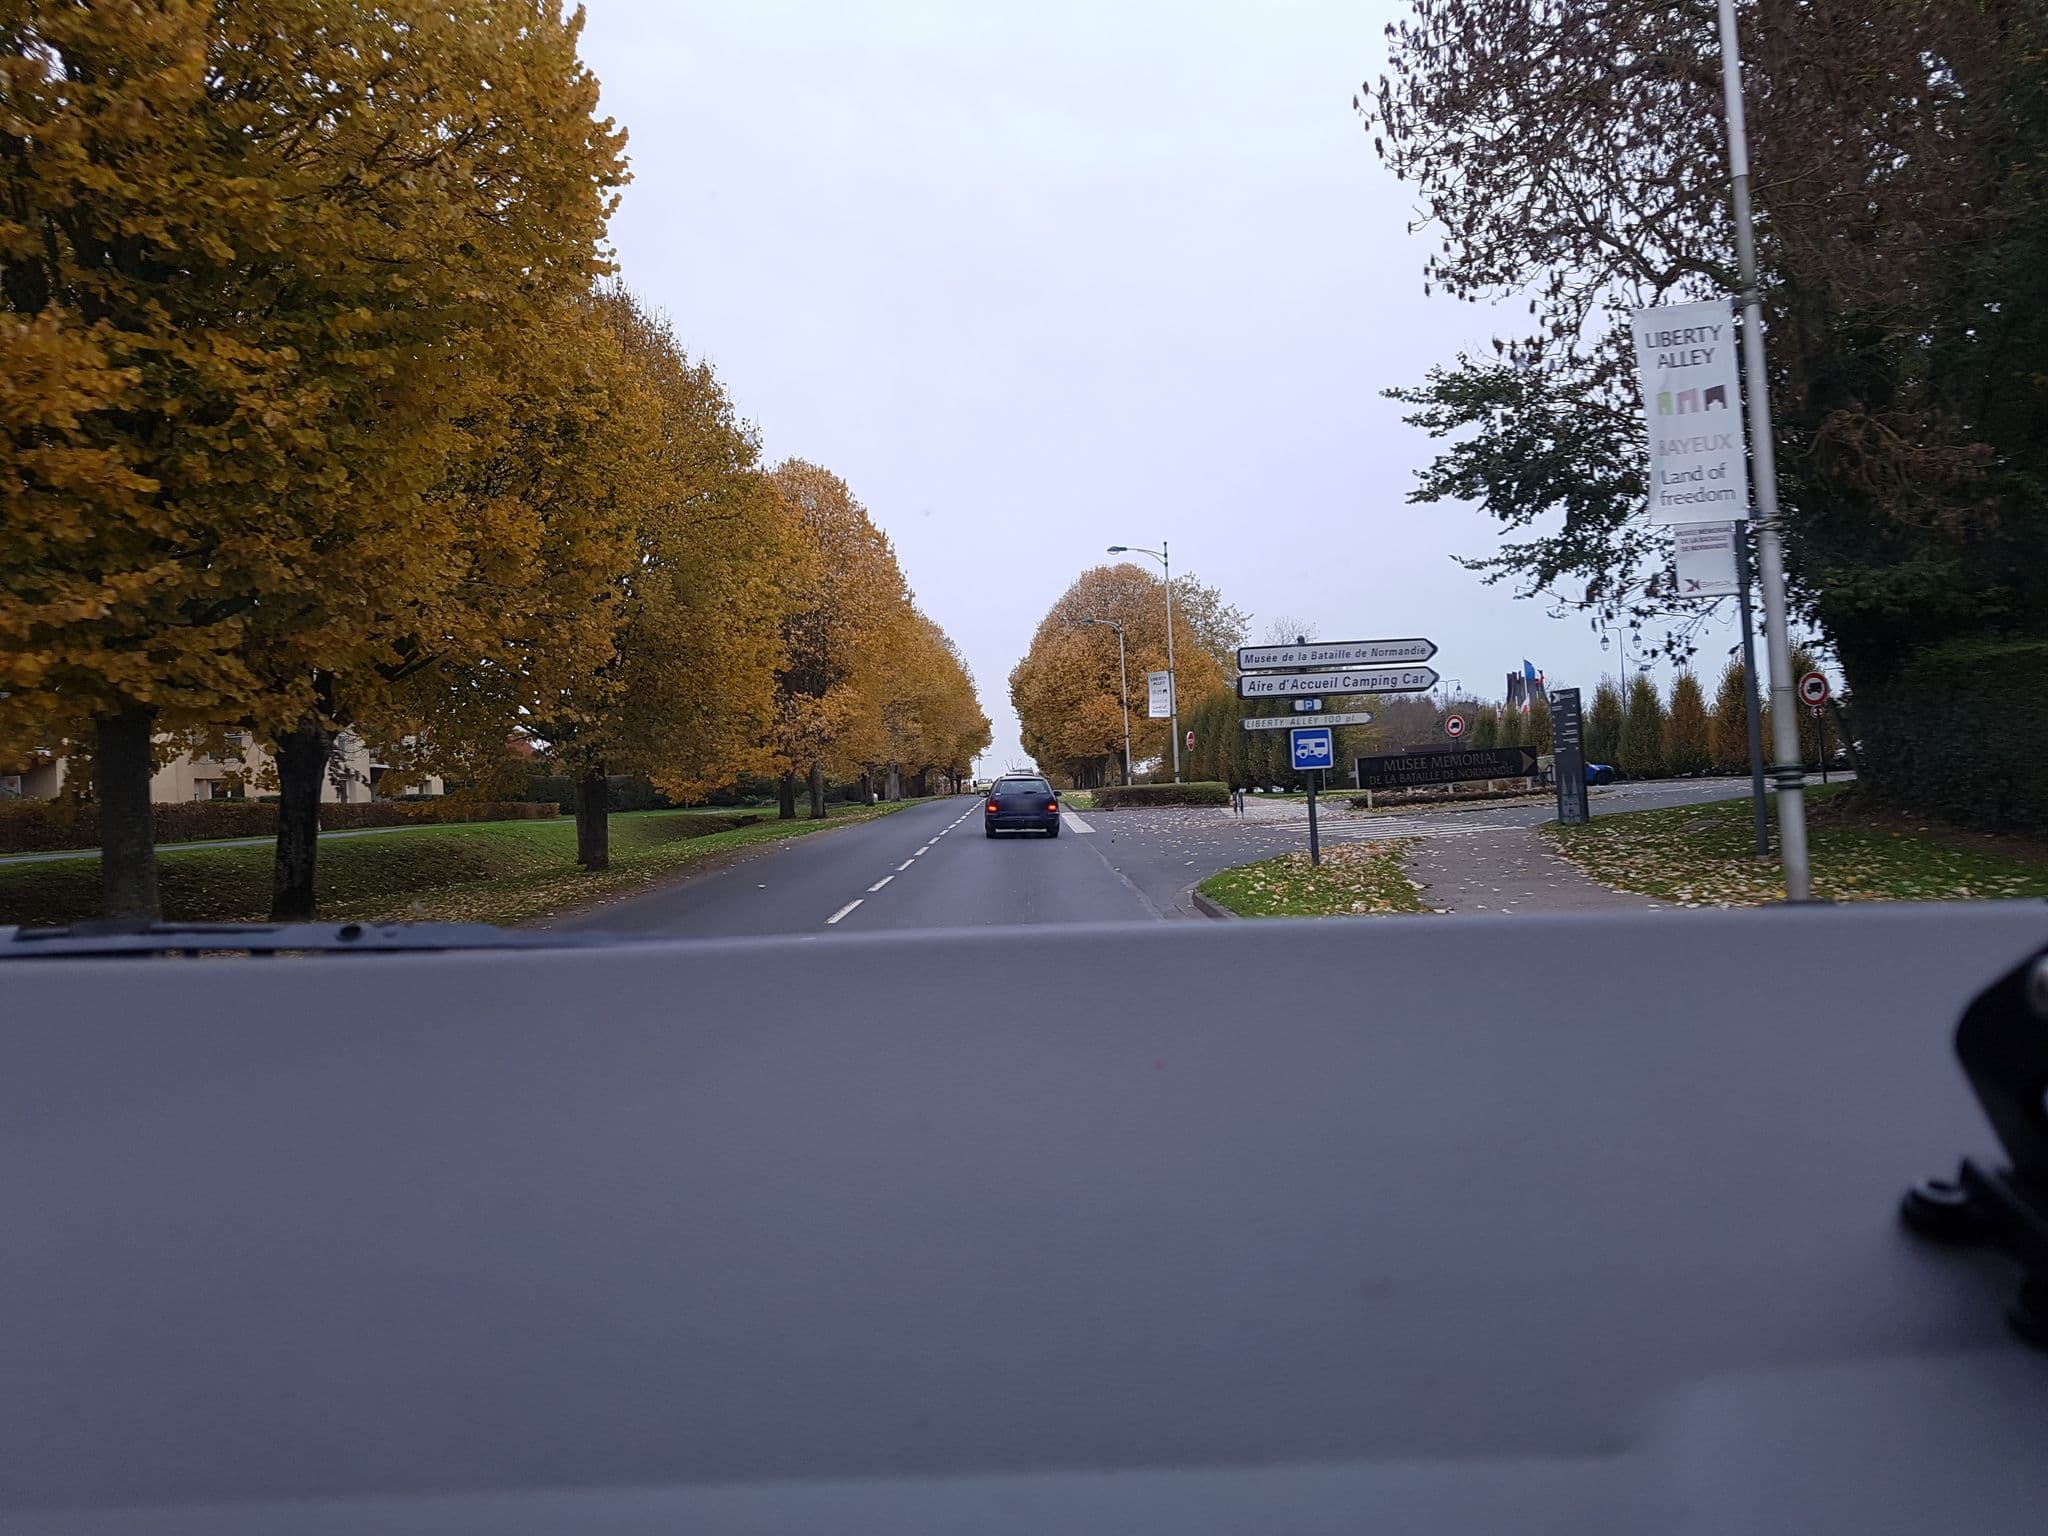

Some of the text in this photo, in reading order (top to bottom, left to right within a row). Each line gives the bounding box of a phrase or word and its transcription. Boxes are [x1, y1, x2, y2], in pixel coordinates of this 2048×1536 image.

[1645, 324, 1723, 349] LIBERTY
[1656, 347, 1716, 369] ALLEY
[1660, 461, 1728, 485] Land of
[1660, 486, 1736, 506] freedom
[1282, 652, 1294, 662] de
[1298, 652, 1307, 661] la
[1311, 649, 1351, 660] Bataille
[1355, 648, 1367, 658] de
[1370, 645, 1426, 657] Normandie
[1247, 673, 1425, 692] Aire d'Accueil Camping Car
[1304, 700, 1313, 710] P
[1246, 719, 1284, 728] LIBERTY
[1290, 717, 1319, 725] ALLEY
[1324, 715, 1340, 723] 100
[1369, 764, 1515, 785] DE LA BATAILLE DE NORMANDIE
